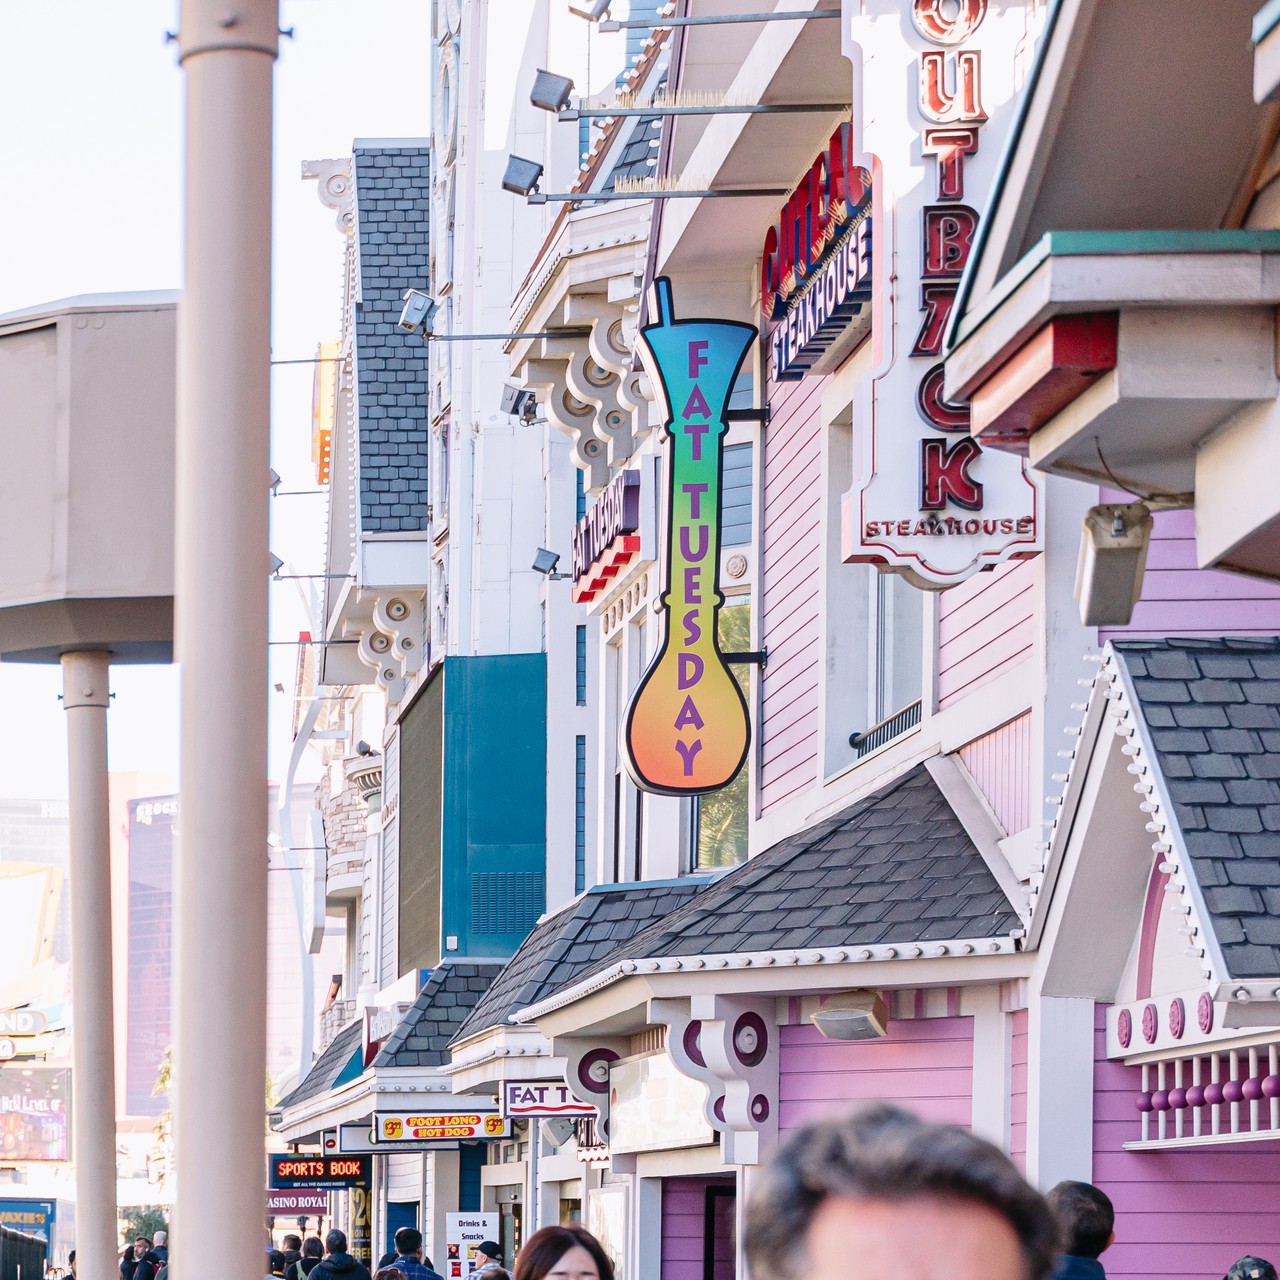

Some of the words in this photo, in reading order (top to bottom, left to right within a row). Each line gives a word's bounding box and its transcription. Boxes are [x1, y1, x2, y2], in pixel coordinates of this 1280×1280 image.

[771, 216, 872, 383] STEAKHOUSE
[682, 340, 712, 461] FAT
[571, 516, 589, 584] FAT
[588, 471, 630, 563] TUESDAY
[865, 514, 1035, 538] STEAKHOUSE
[673, 482, 710, 777] TUESDAY
[509, 1086, 549, 1104] FAT
[409, 1116, 441, 1127] FOOT
[444, 1115, 478, 1126] LONG
[418, 1128, 442, 1137] HOT
[444, 1127, 470, 1137] DOG
[278, 1161, 324, 1177] SPORTS
[329, 1161, 360, 1176] BOOK
[266, 1196, 296, 1208] ASINO
[297, 1196, 328, 1208] ROYAL
